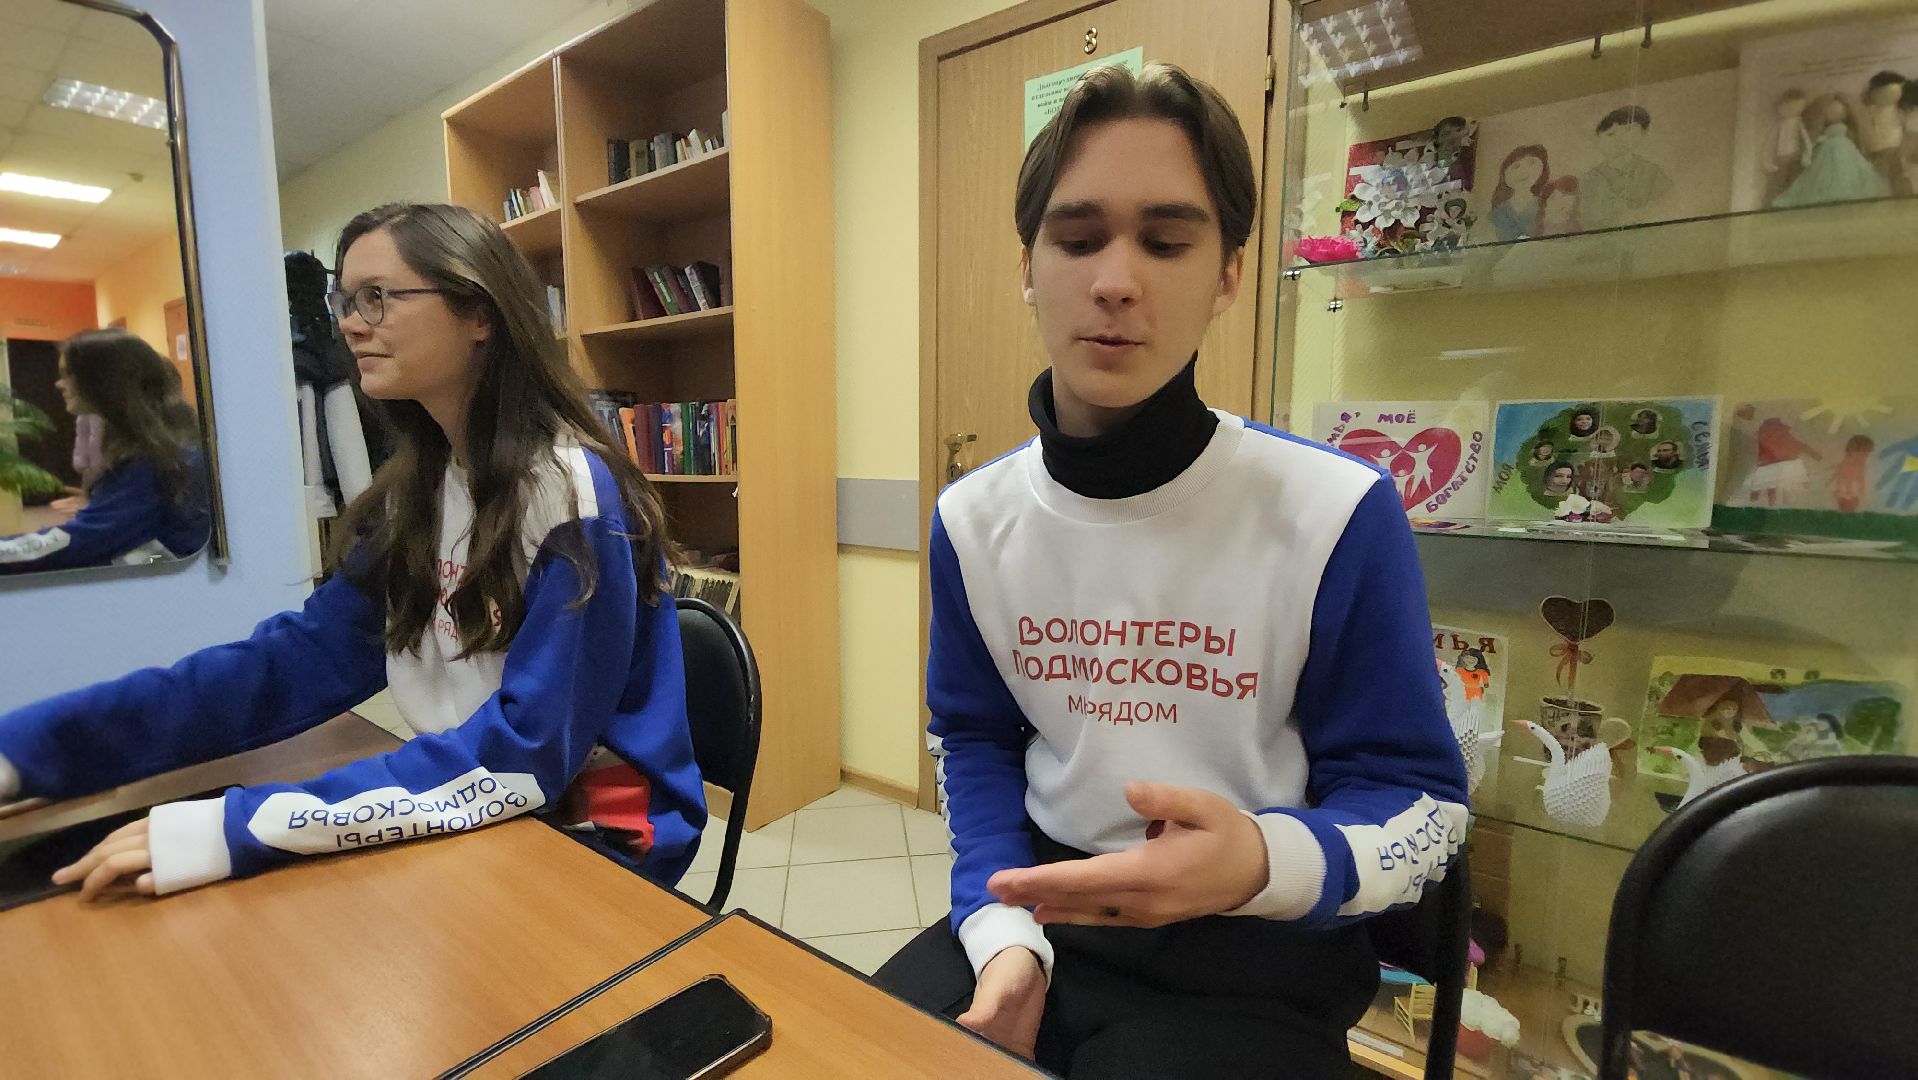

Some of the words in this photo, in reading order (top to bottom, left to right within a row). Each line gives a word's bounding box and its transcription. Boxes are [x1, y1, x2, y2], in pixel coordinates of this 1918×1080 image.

[1377, 409, 1417, 424] МОЁ
[1425, 430, 1483, 513] БОГАТСТВО
[1018, 616, 1236, 656] ВОЛОНТЕРЫ
[1012, 650, 1259, 700] ПОДМОСКОВЬЯ
[287, 777, 497, 829] ОДМОСКОВЬЯ
